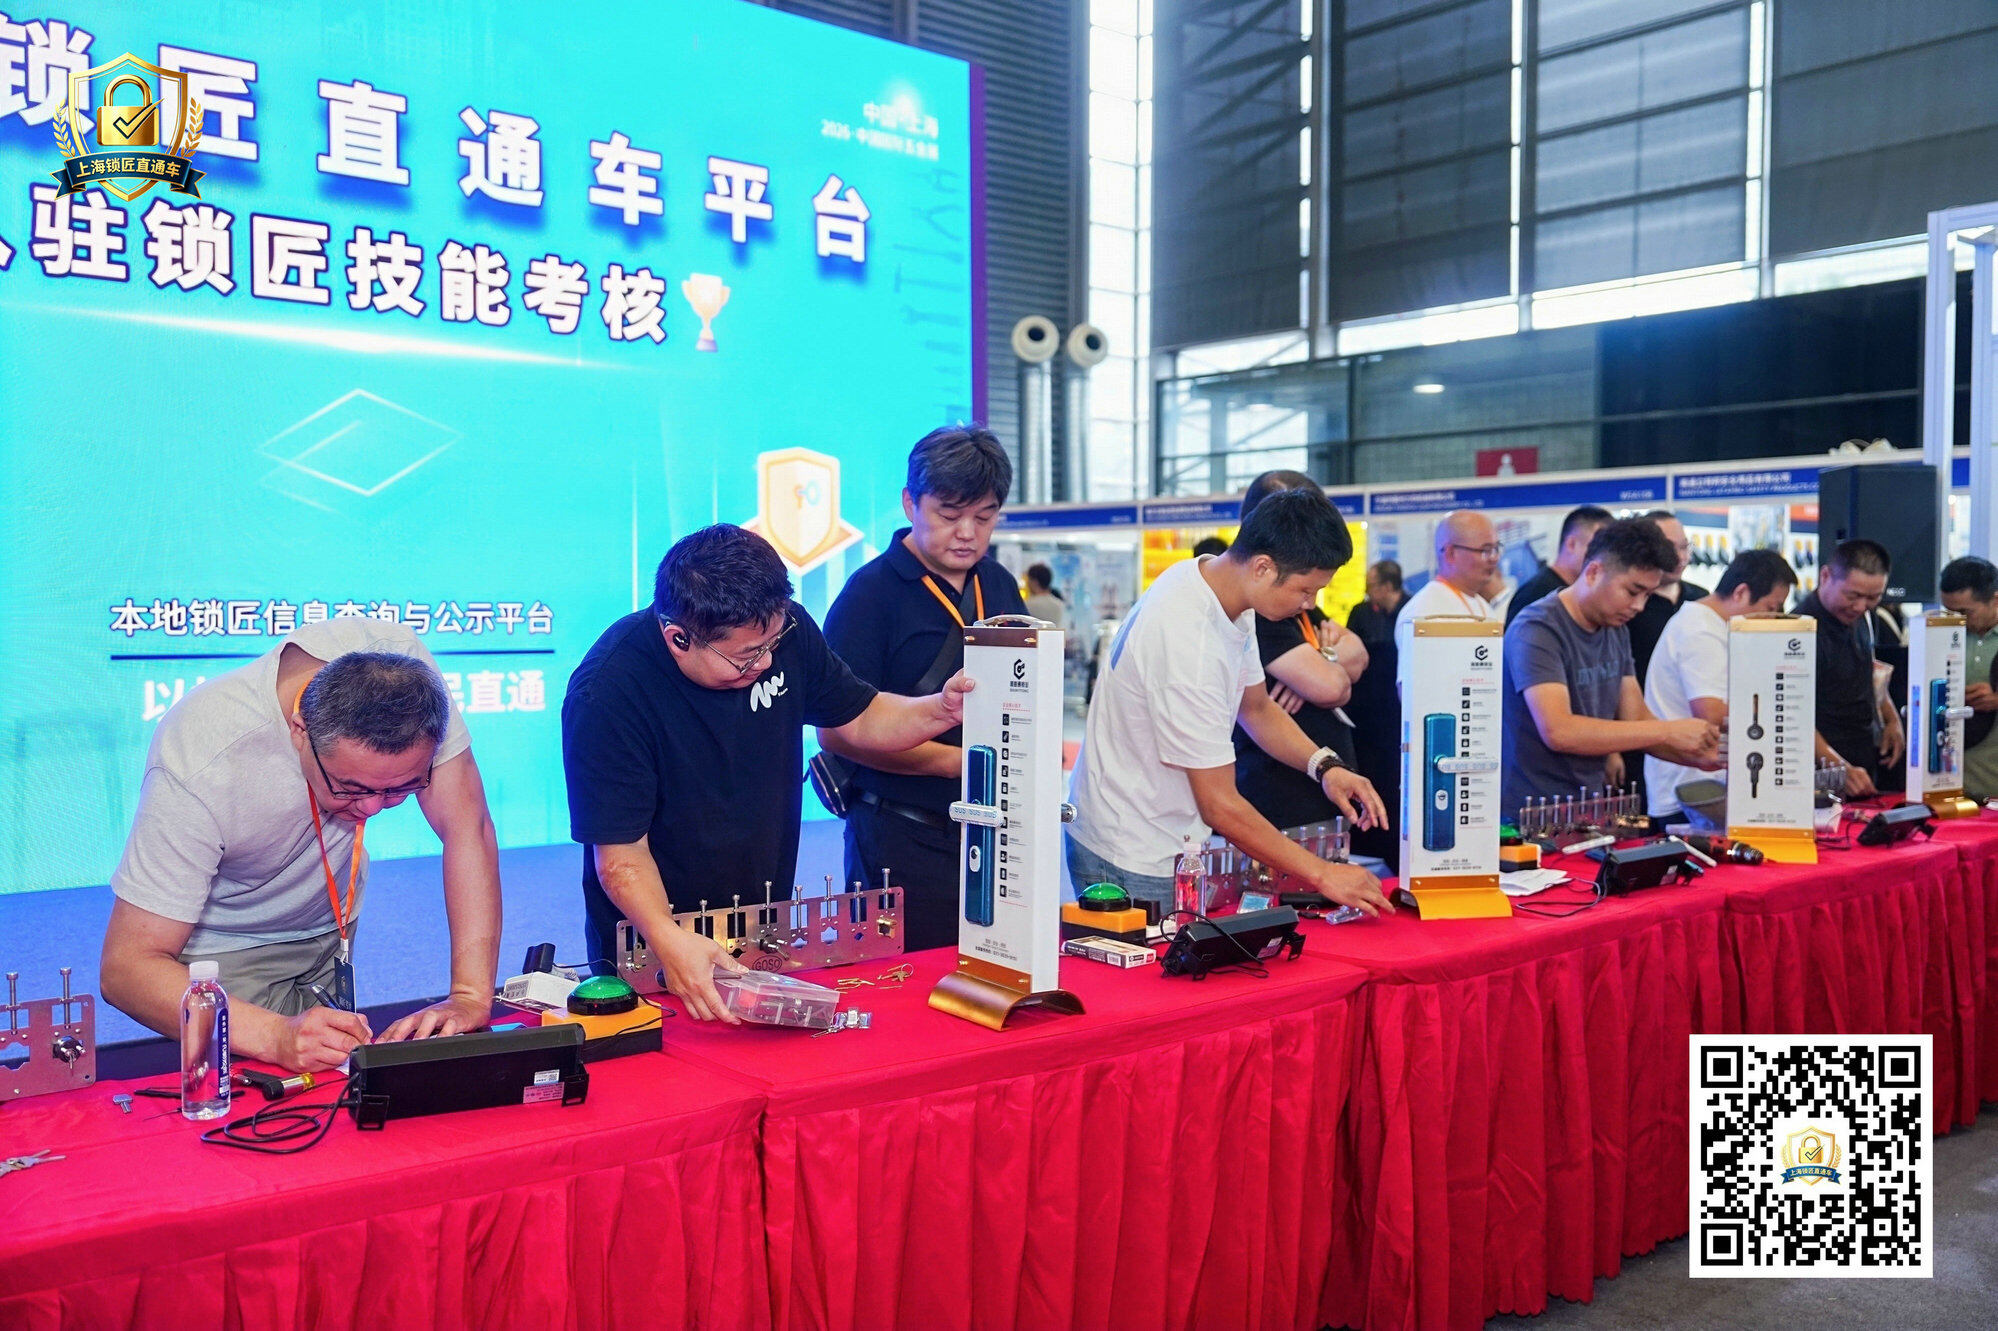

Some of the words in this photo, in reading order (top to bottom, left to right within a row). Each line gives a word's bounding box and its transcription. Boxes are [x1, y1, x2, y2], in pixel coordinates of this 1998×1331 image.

[0, 184, 667, 344] 驻锁匠技能考核
[755, 958, 780, 971] GOSO
